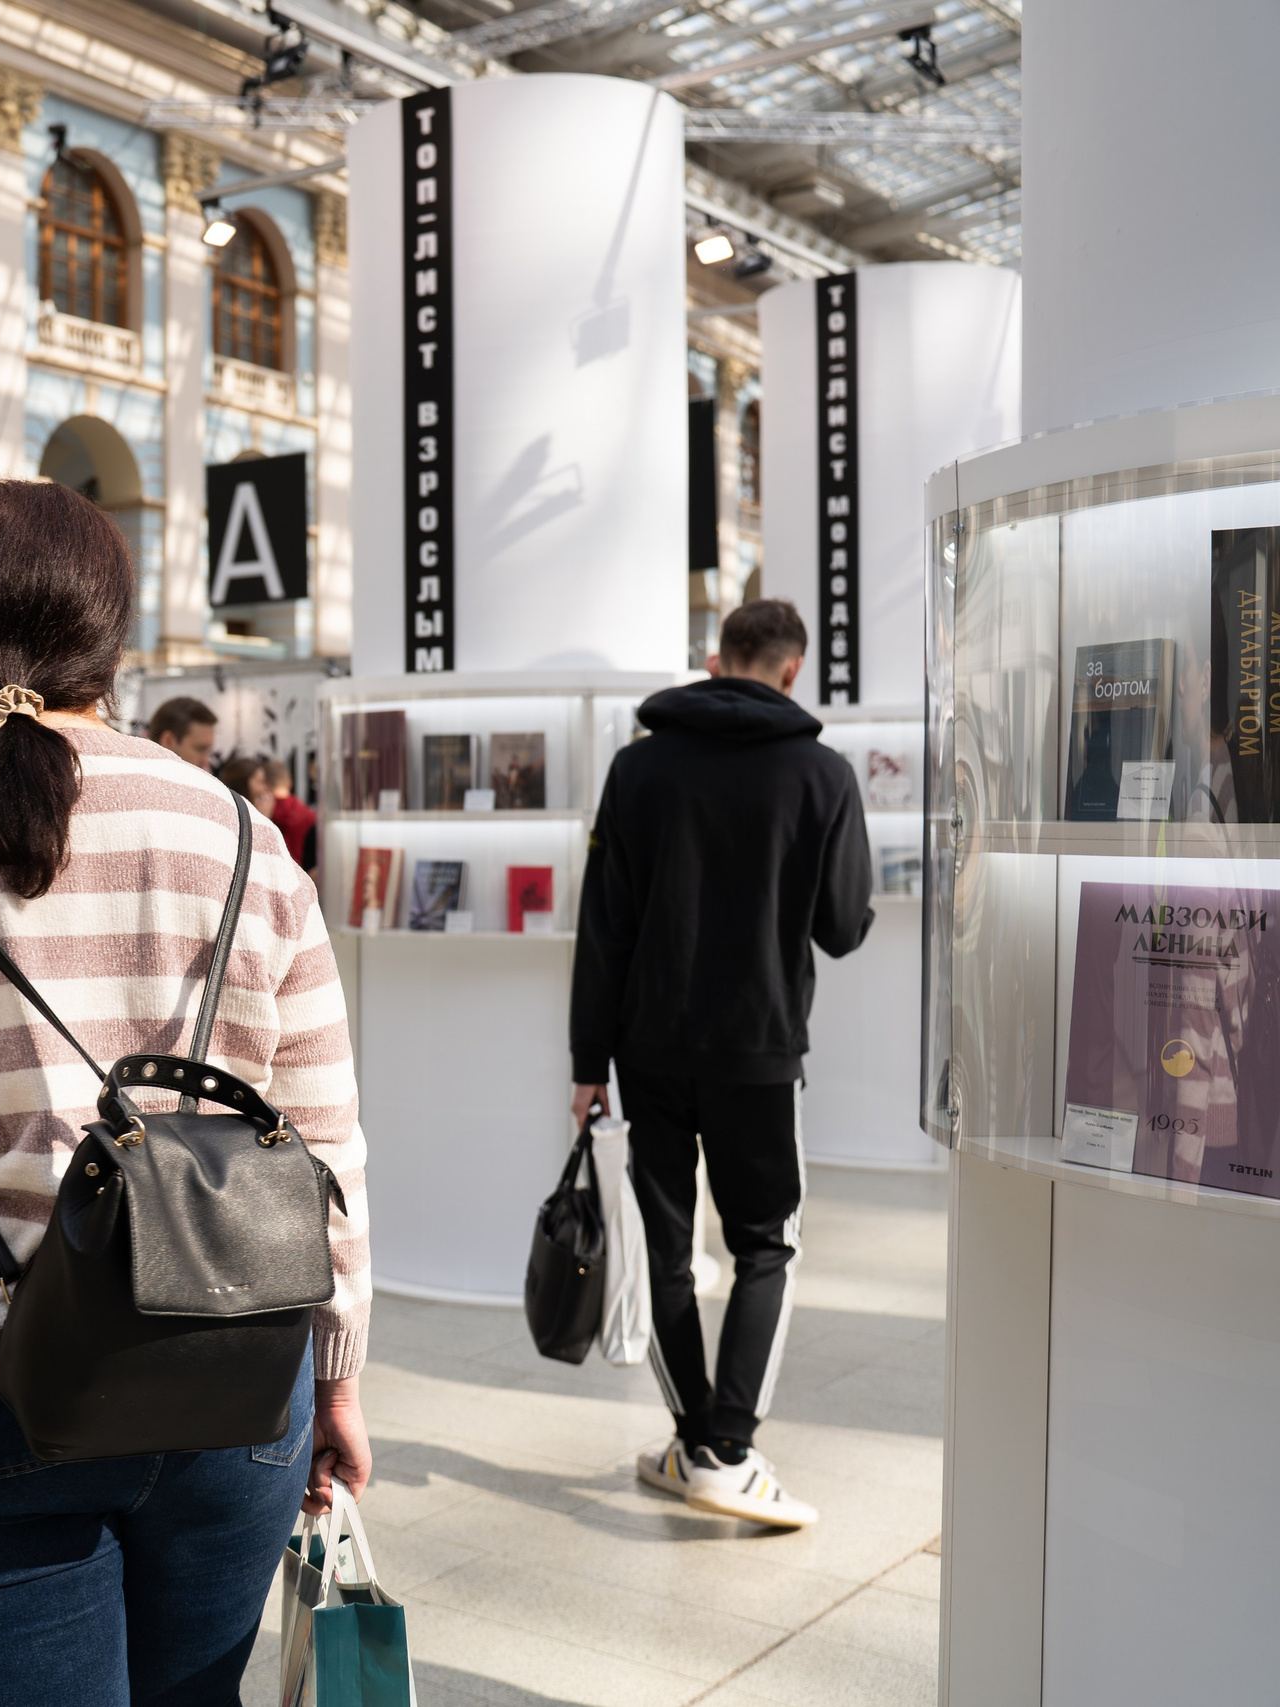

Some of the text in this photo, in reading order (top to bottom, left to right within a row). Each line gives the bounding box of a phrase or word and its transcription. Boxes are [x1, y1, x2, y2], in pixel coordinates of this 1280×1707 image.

[211, 481, 286, 605] A
[1086, 661, 1103, 677] за
[1237, 589, 1262, 757] ДЕЛАБАРТОМ
[1094, 678, 1150, 700] бортом
[1114, 904, 1267, 932] МАВЗОЛЕЙ
[1133, 932, 1240, 958] ЛЕНИНА
